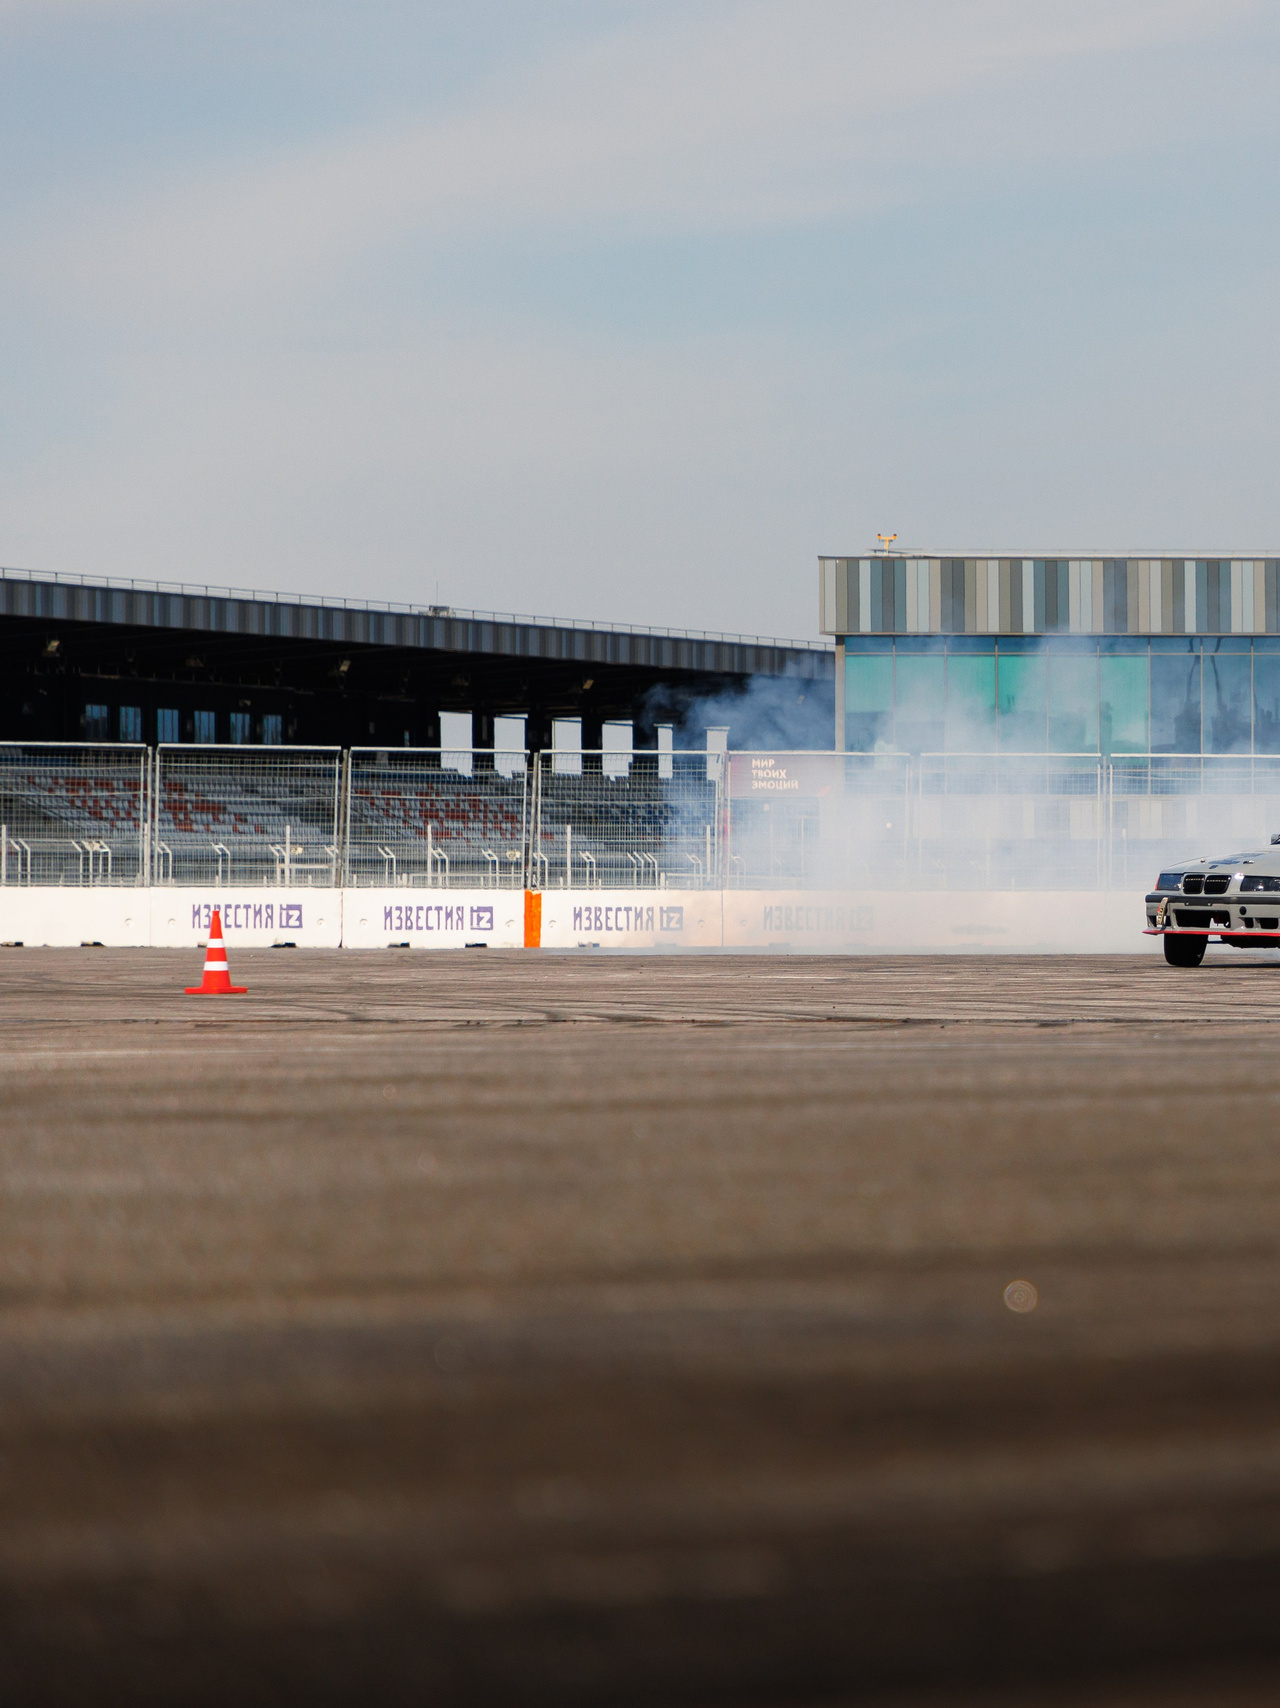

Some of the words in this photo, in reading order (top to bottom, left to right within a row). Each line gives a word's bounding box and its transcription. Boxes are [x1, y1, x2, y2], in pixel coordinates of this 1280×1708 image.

[751, 758, 775, 768] МИР
[751, 768, 787, 779] ТВОИХ
[751, 779, 799, 790] ЭМОЦИЙ
[384, 906, 464, 931] ИЗВЕСТИЯ
[573, 906, 655, 931] ИЗВЕСТИЯ
[763, 905, 845, 931] ИЗВЕСТИЯ
